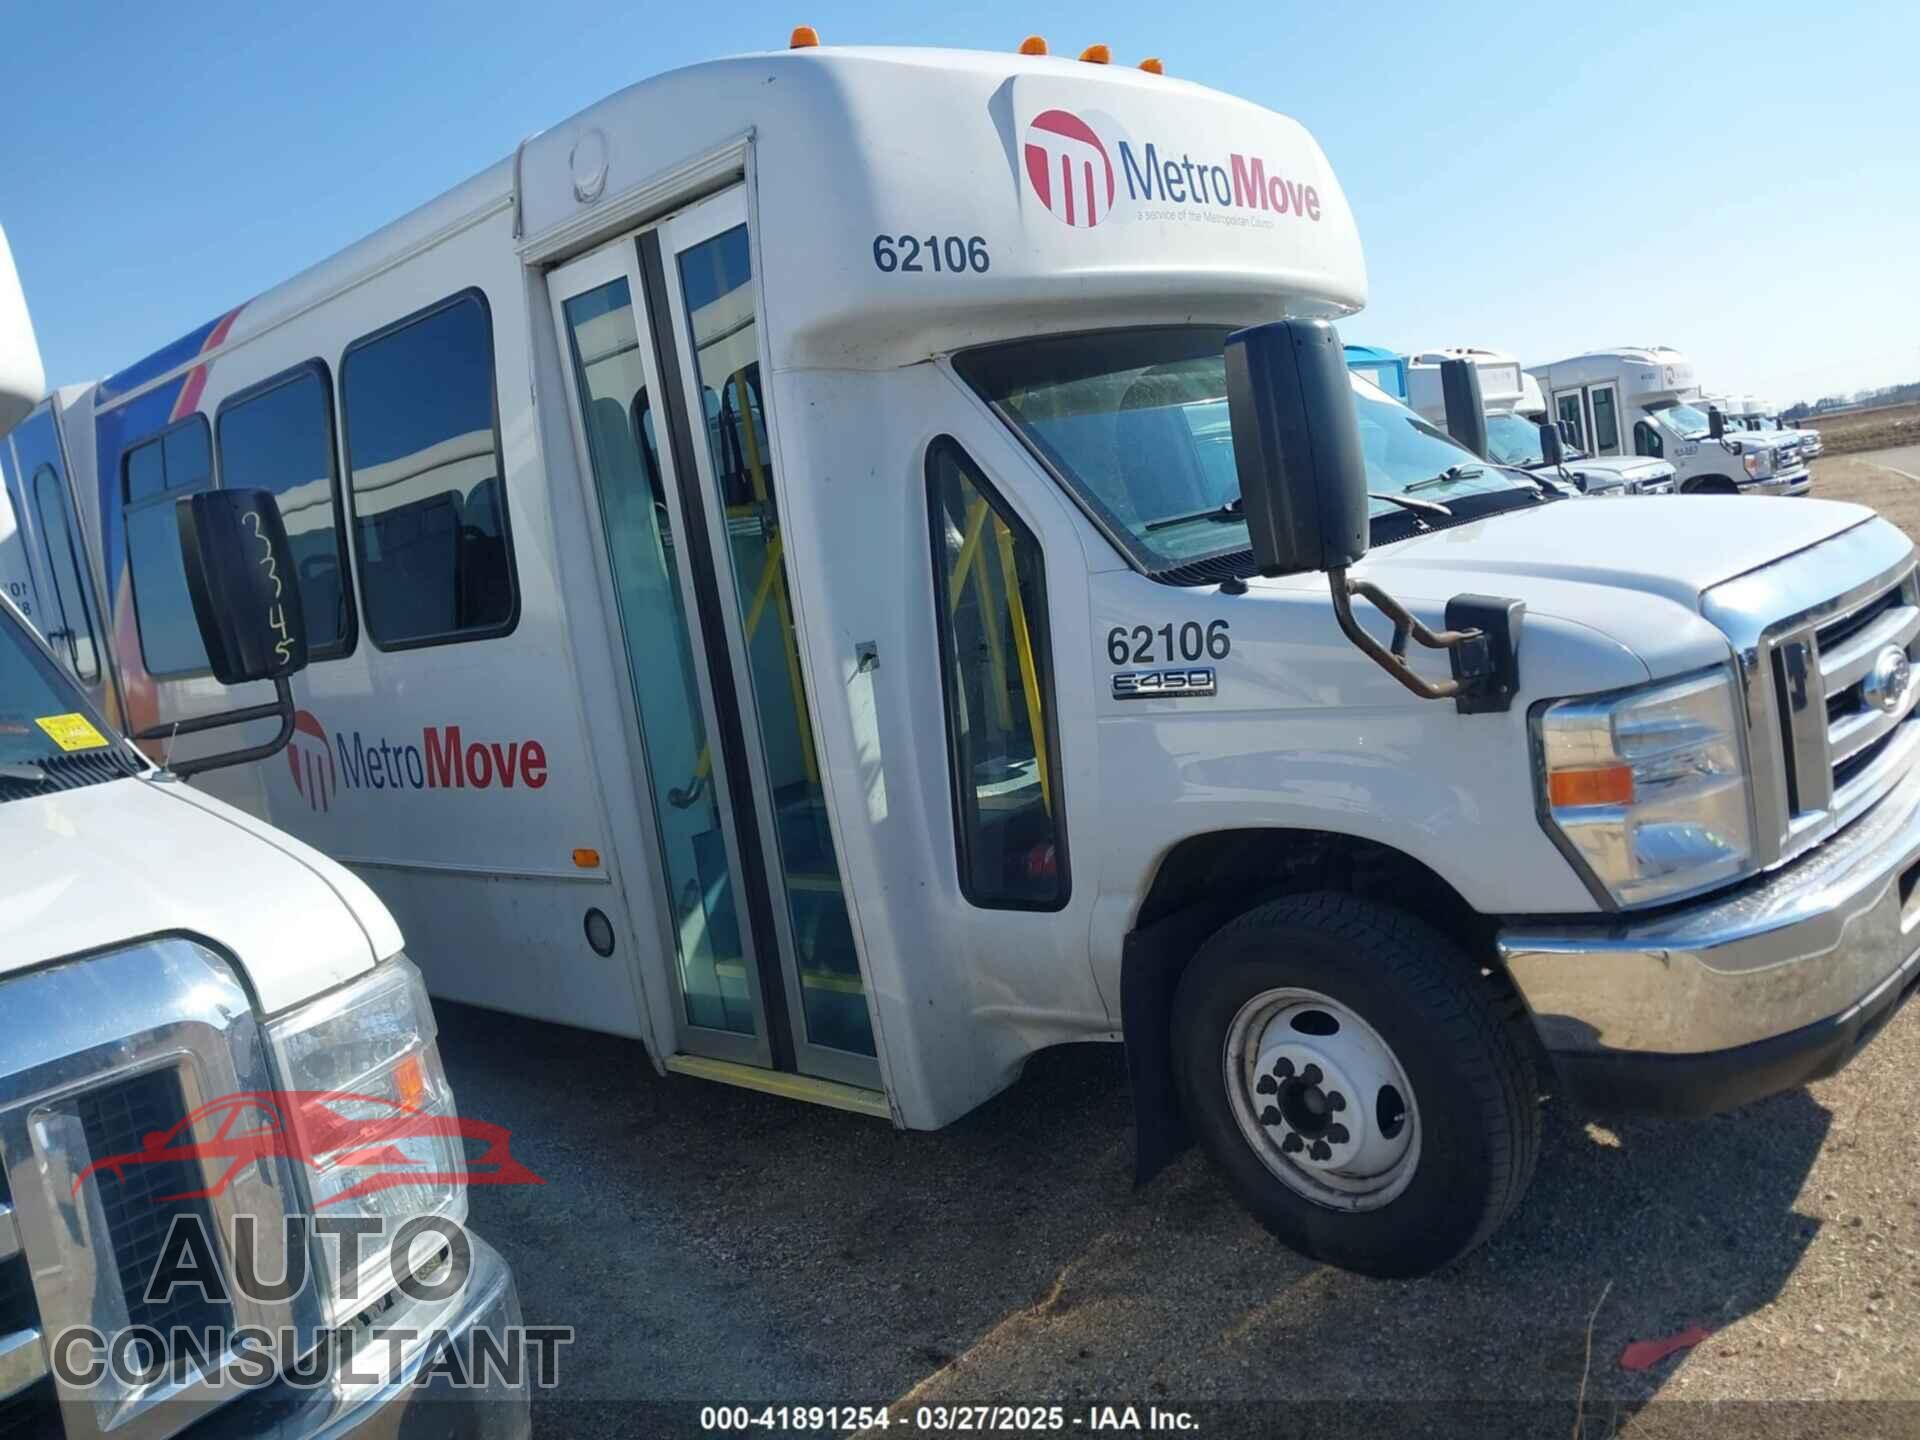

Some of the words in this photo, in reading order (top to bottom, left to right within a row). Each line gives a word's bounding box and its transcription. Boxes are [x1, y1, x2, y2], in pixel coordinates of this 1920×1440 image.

[1118, 140, 1321, 221] MetroMove
[873, 234, 990, 273] 62106
[1107, 619, 1231, 666] 62106
[336, 726, 548, 789] MetroMove
